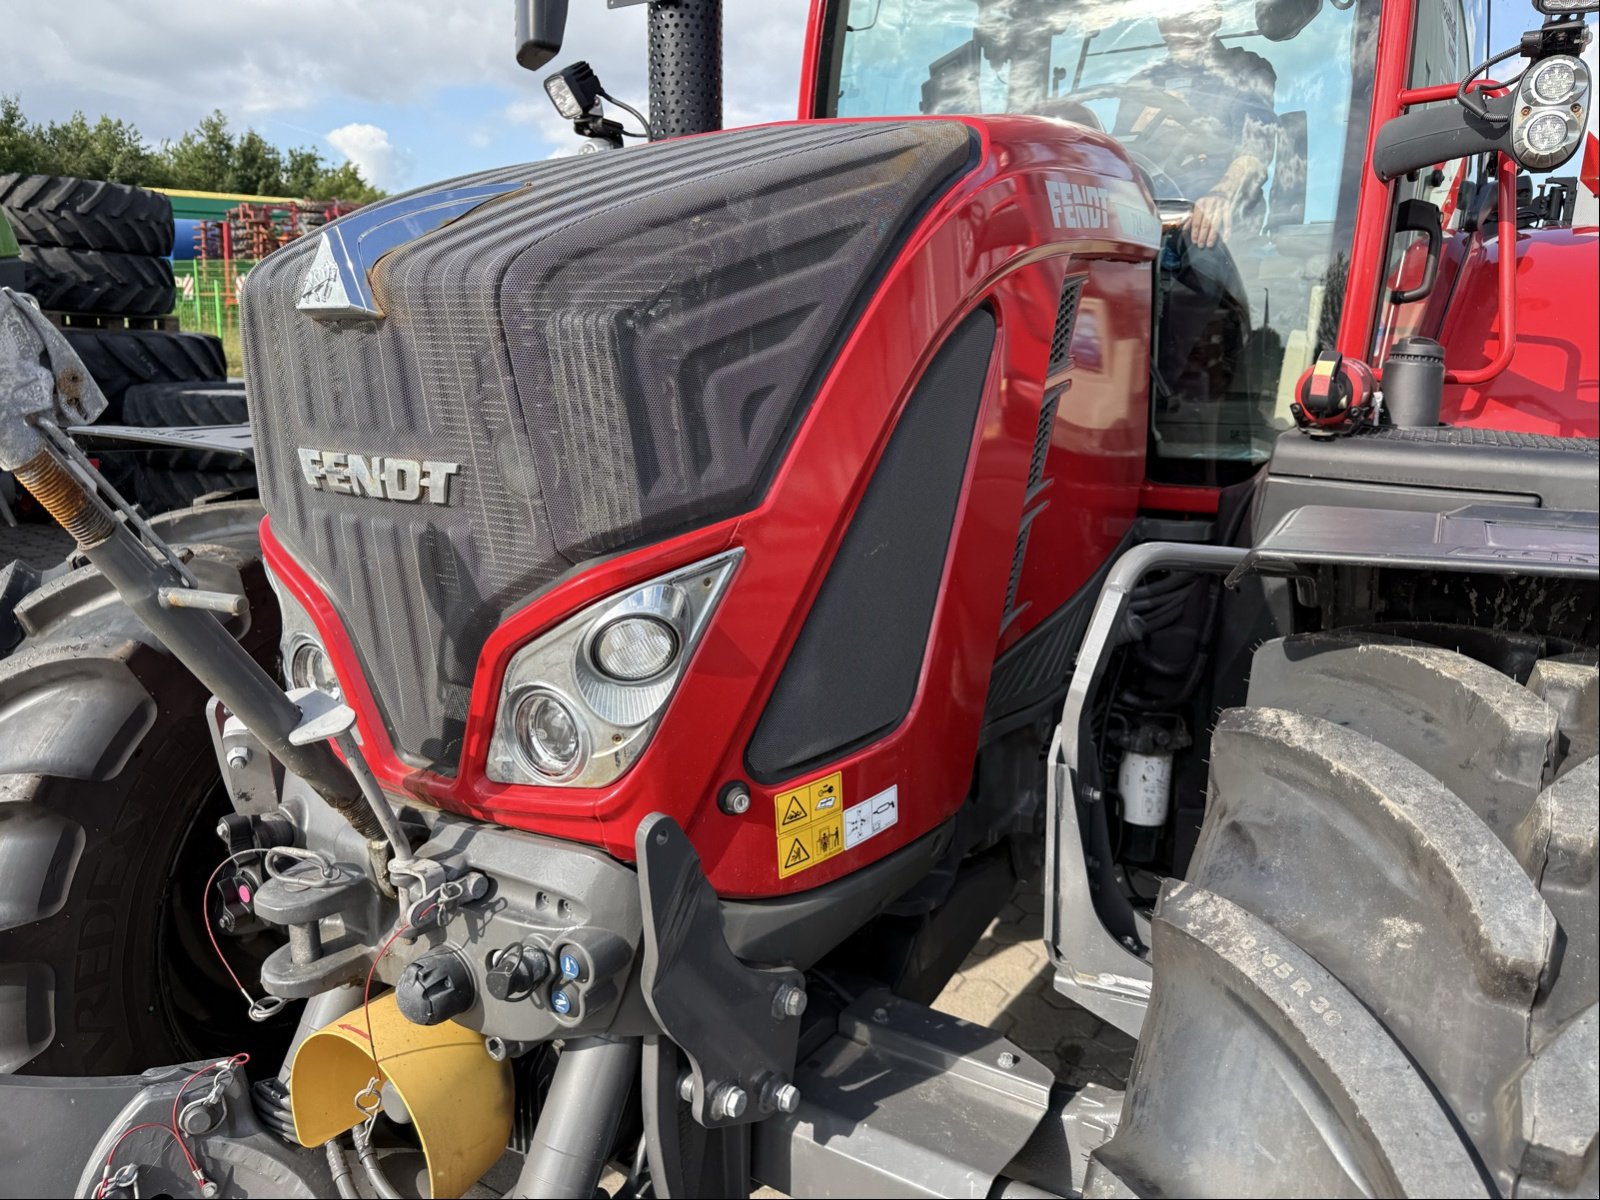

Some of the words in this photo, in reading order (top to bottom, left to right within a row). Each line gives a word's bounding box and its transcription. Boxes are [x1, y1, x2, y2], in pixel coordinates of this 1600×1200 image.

[1045, 180, 1109, 229] FENDT
[297, 446, 460, 505] FENDT
[1289, 976, 1312, 998] R
